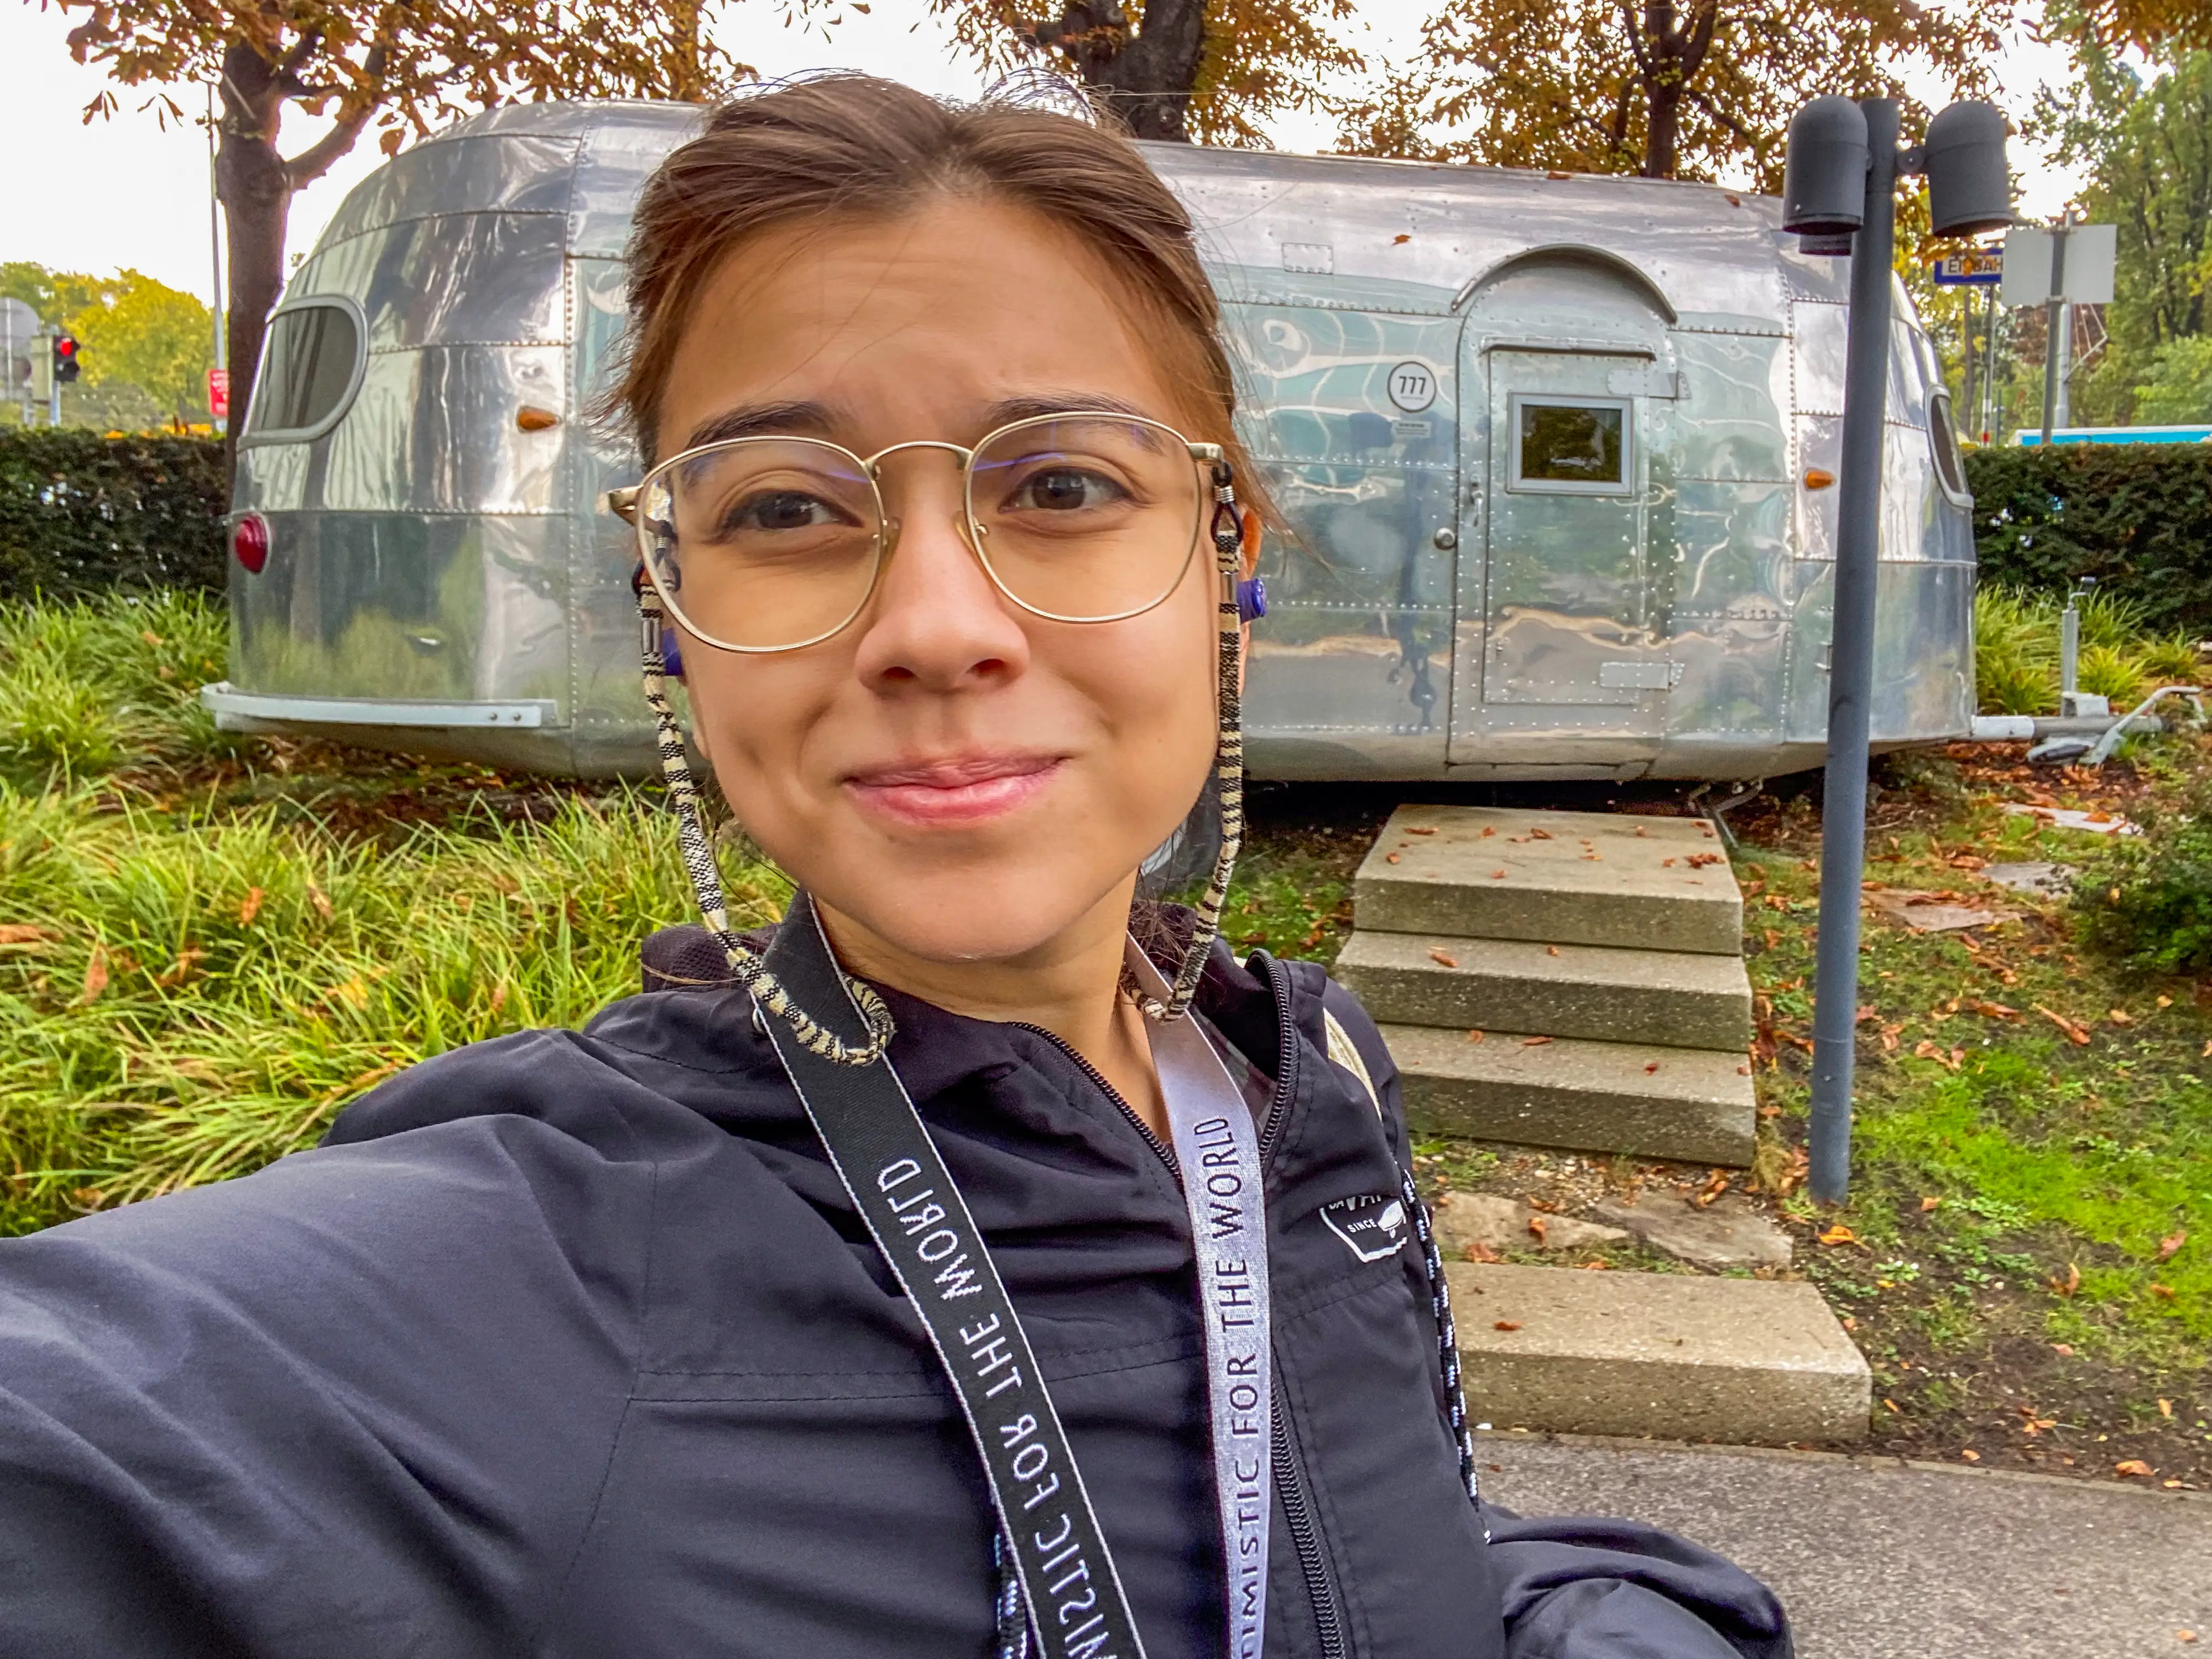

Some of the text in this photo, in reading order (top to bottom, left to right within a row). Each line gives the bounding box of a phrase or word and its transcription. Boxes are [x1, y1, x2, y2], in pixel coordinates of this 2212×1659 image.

[1949, 257, 2003, 273] EIBAH
[1399, 376, 1426, 394] 777
[1194, 1118, 1243, 1239] WORLD
[1347, 1218, 1377, 1233] SINCE
[1215, 1260, 1254, 1333] THE
[1227, 1353, 1258, 1436] FOR
